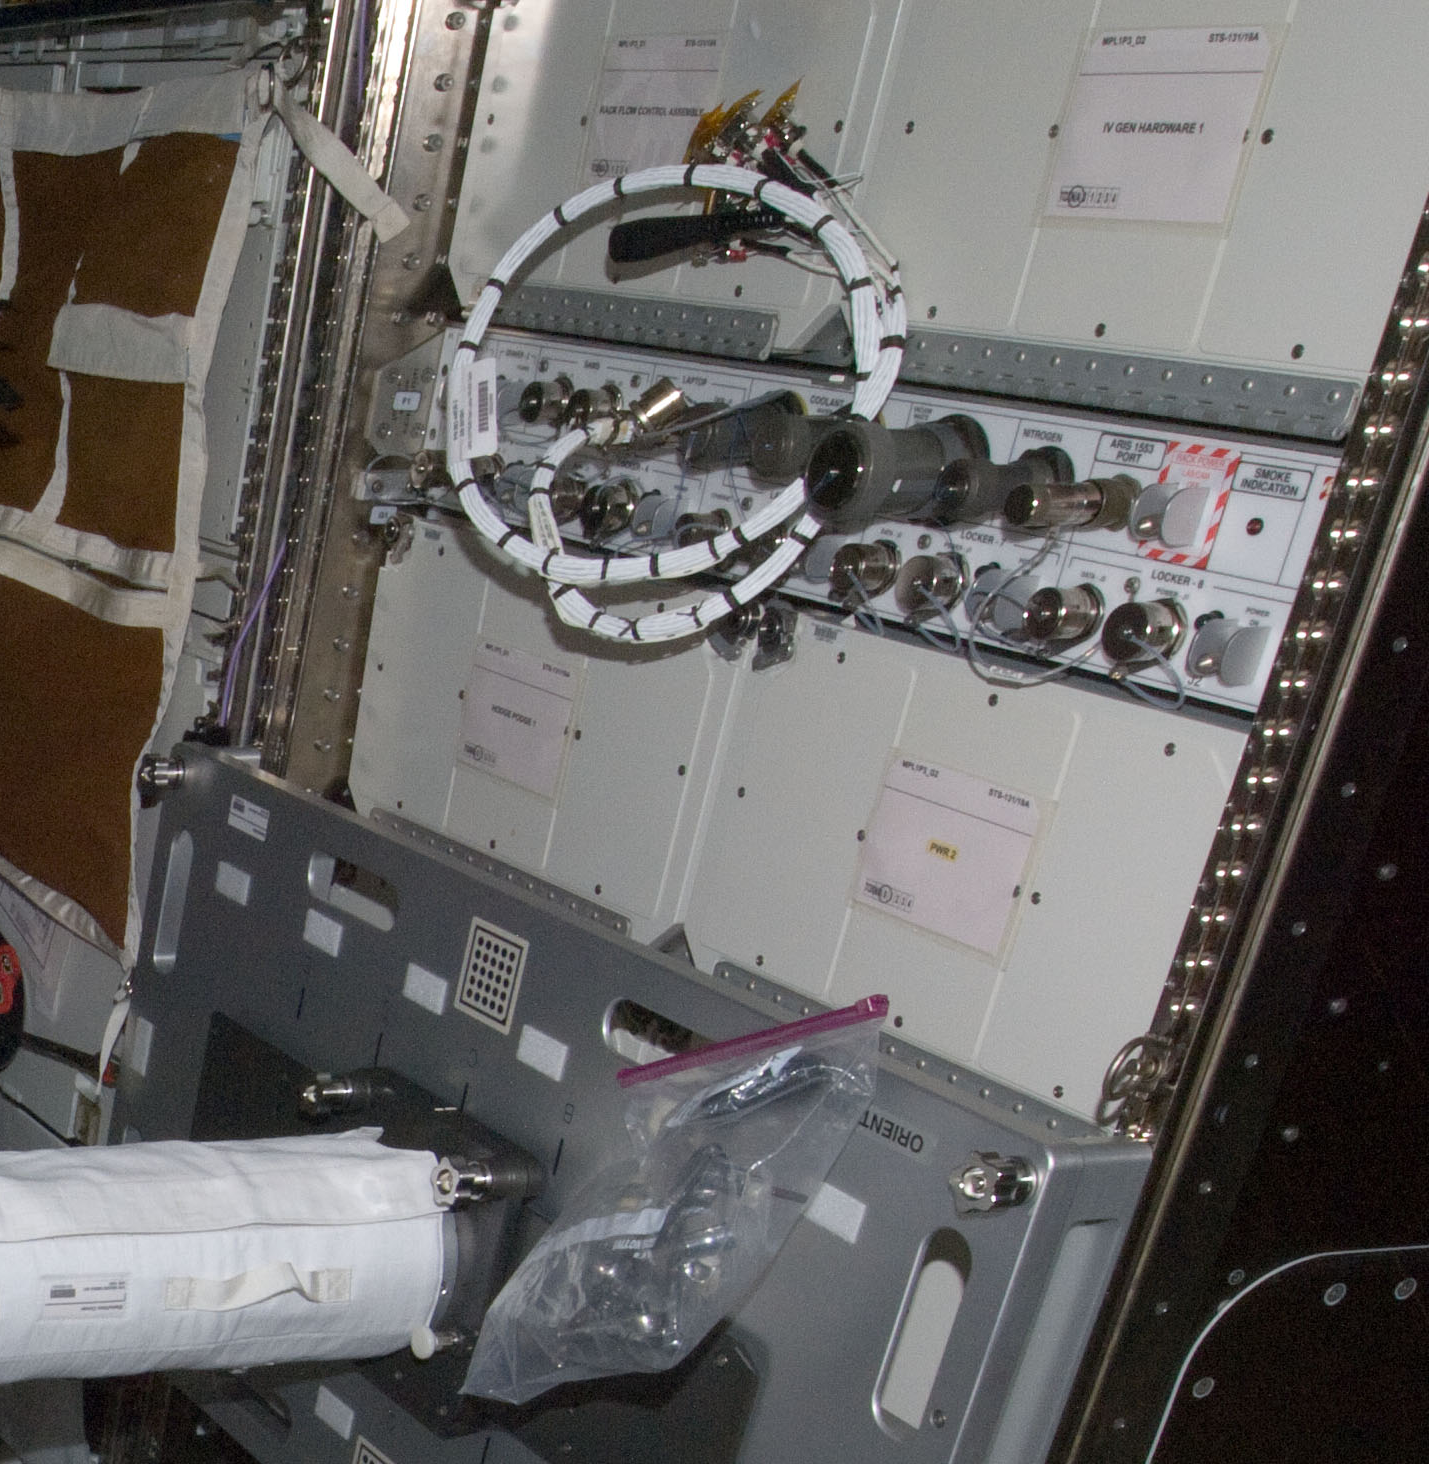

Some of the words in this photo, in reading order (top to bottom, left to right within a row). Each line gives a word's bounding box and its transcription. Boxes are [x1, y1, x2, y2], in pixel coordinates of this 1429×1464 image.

[1115, 122, 1137, 134] GEN
[1137, 122, 1196, 135] HARDWARE
[1022, 427, 1063, 444] NITROGEN
[1110, 436, 1133, 451] ARIS
[1115, 449, 1143, 464] PORT
[1253, 466, 1292, 484] SMOKE
[1239, 477, 1300, 498] INDICATION
[1151, 568, 1190, 589] LOCKER
[949, 848, 958, 861] 2
[857, 1110, 925, 1154] ORIENT
